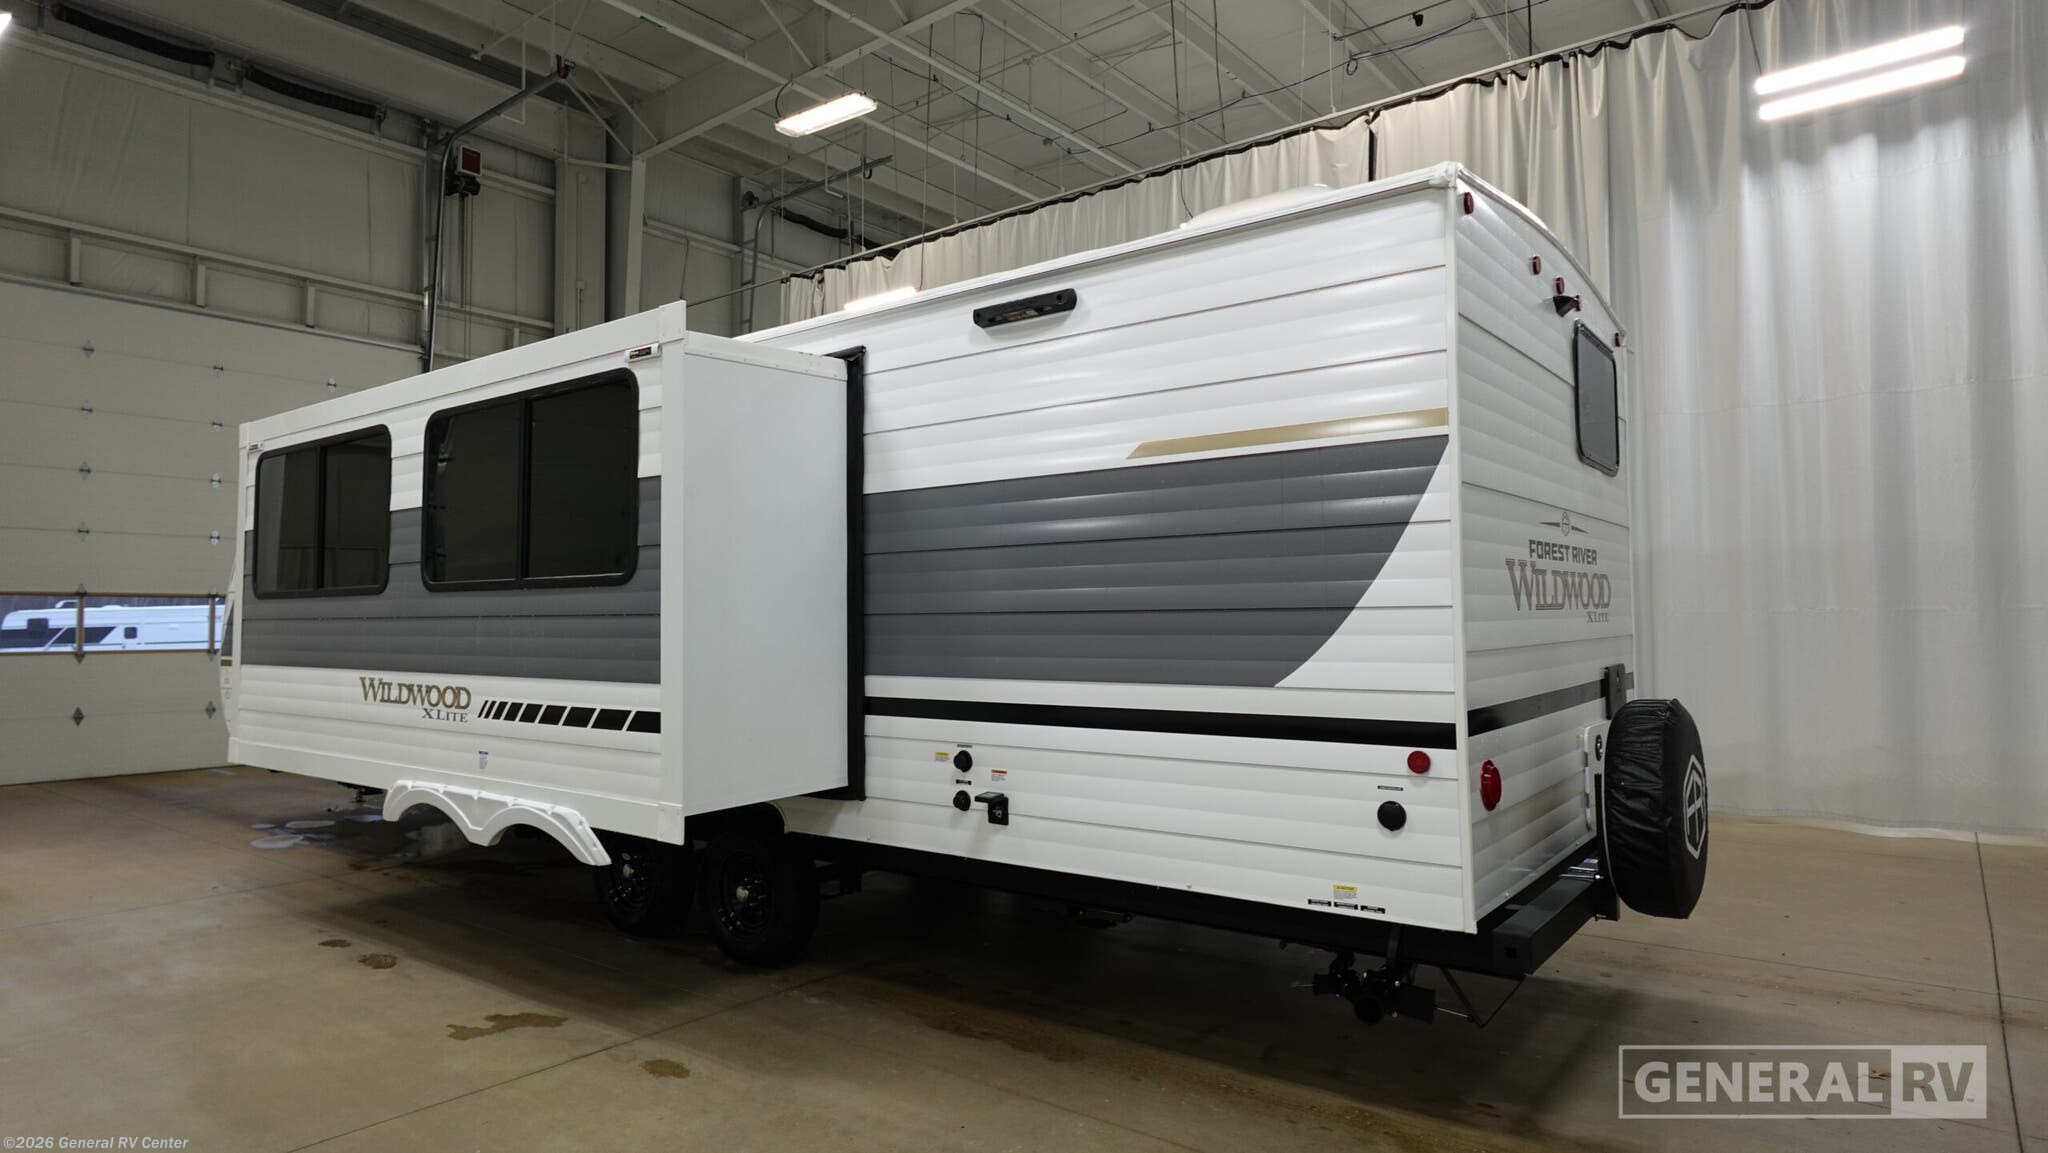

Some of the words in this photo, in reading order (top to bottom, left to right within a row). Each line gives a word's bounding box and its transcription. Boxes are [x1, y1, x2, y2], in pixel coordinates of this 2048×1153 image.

[1528, 539, 1570, 562] FOREST
[1572, 545, 1598, 565] RIVER
[1505, 558, 1611, 611] WILDWOOD
[360, 676, 472, 710] WILDWOOD
